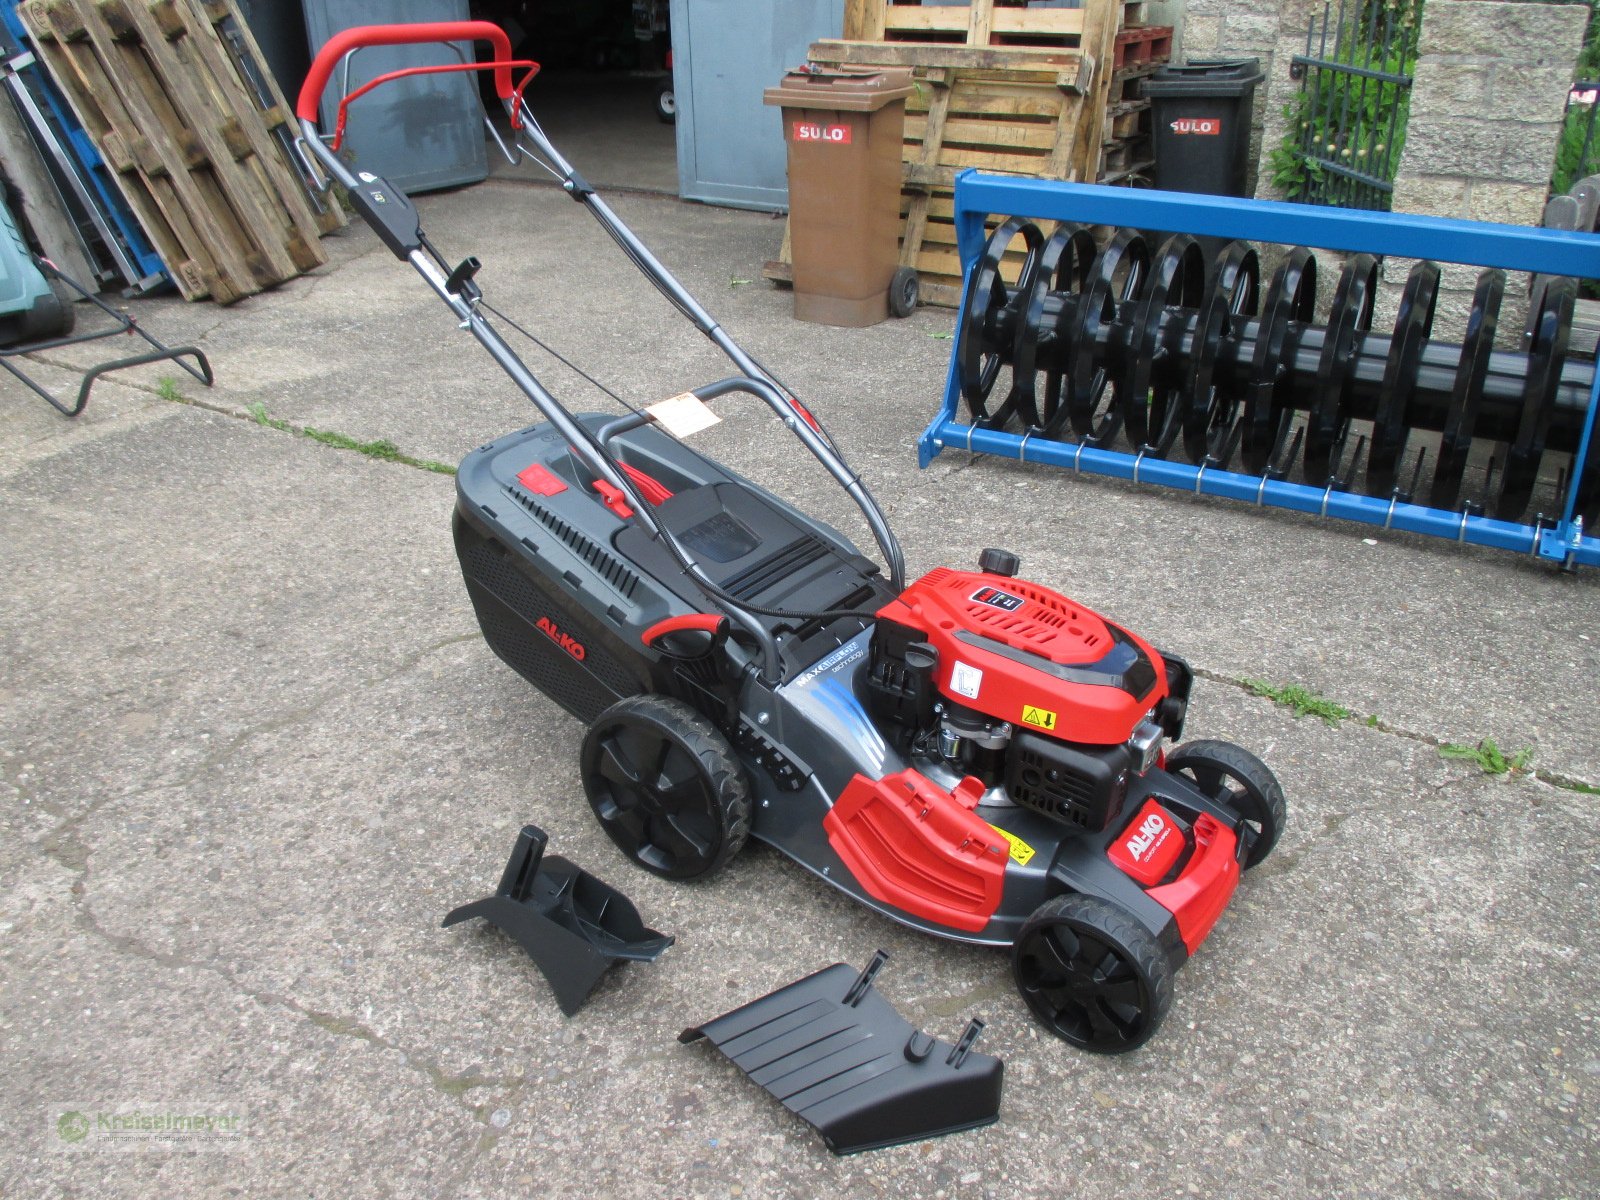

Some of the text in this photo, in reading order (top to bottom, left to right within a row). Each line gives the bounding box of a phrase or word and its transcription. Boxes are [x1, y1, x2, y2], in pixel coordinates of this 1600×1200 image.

[799, 126, 843, 141] SULO
[1170, 121, 1212, 132] SULO
[535, 616, 585, 661] AL-KO
[796, 641, 859, 687] MAX AIRFLOW
[831, 649, 864, 673] technology
[1126, 814, 1165, 862] AL-KO
